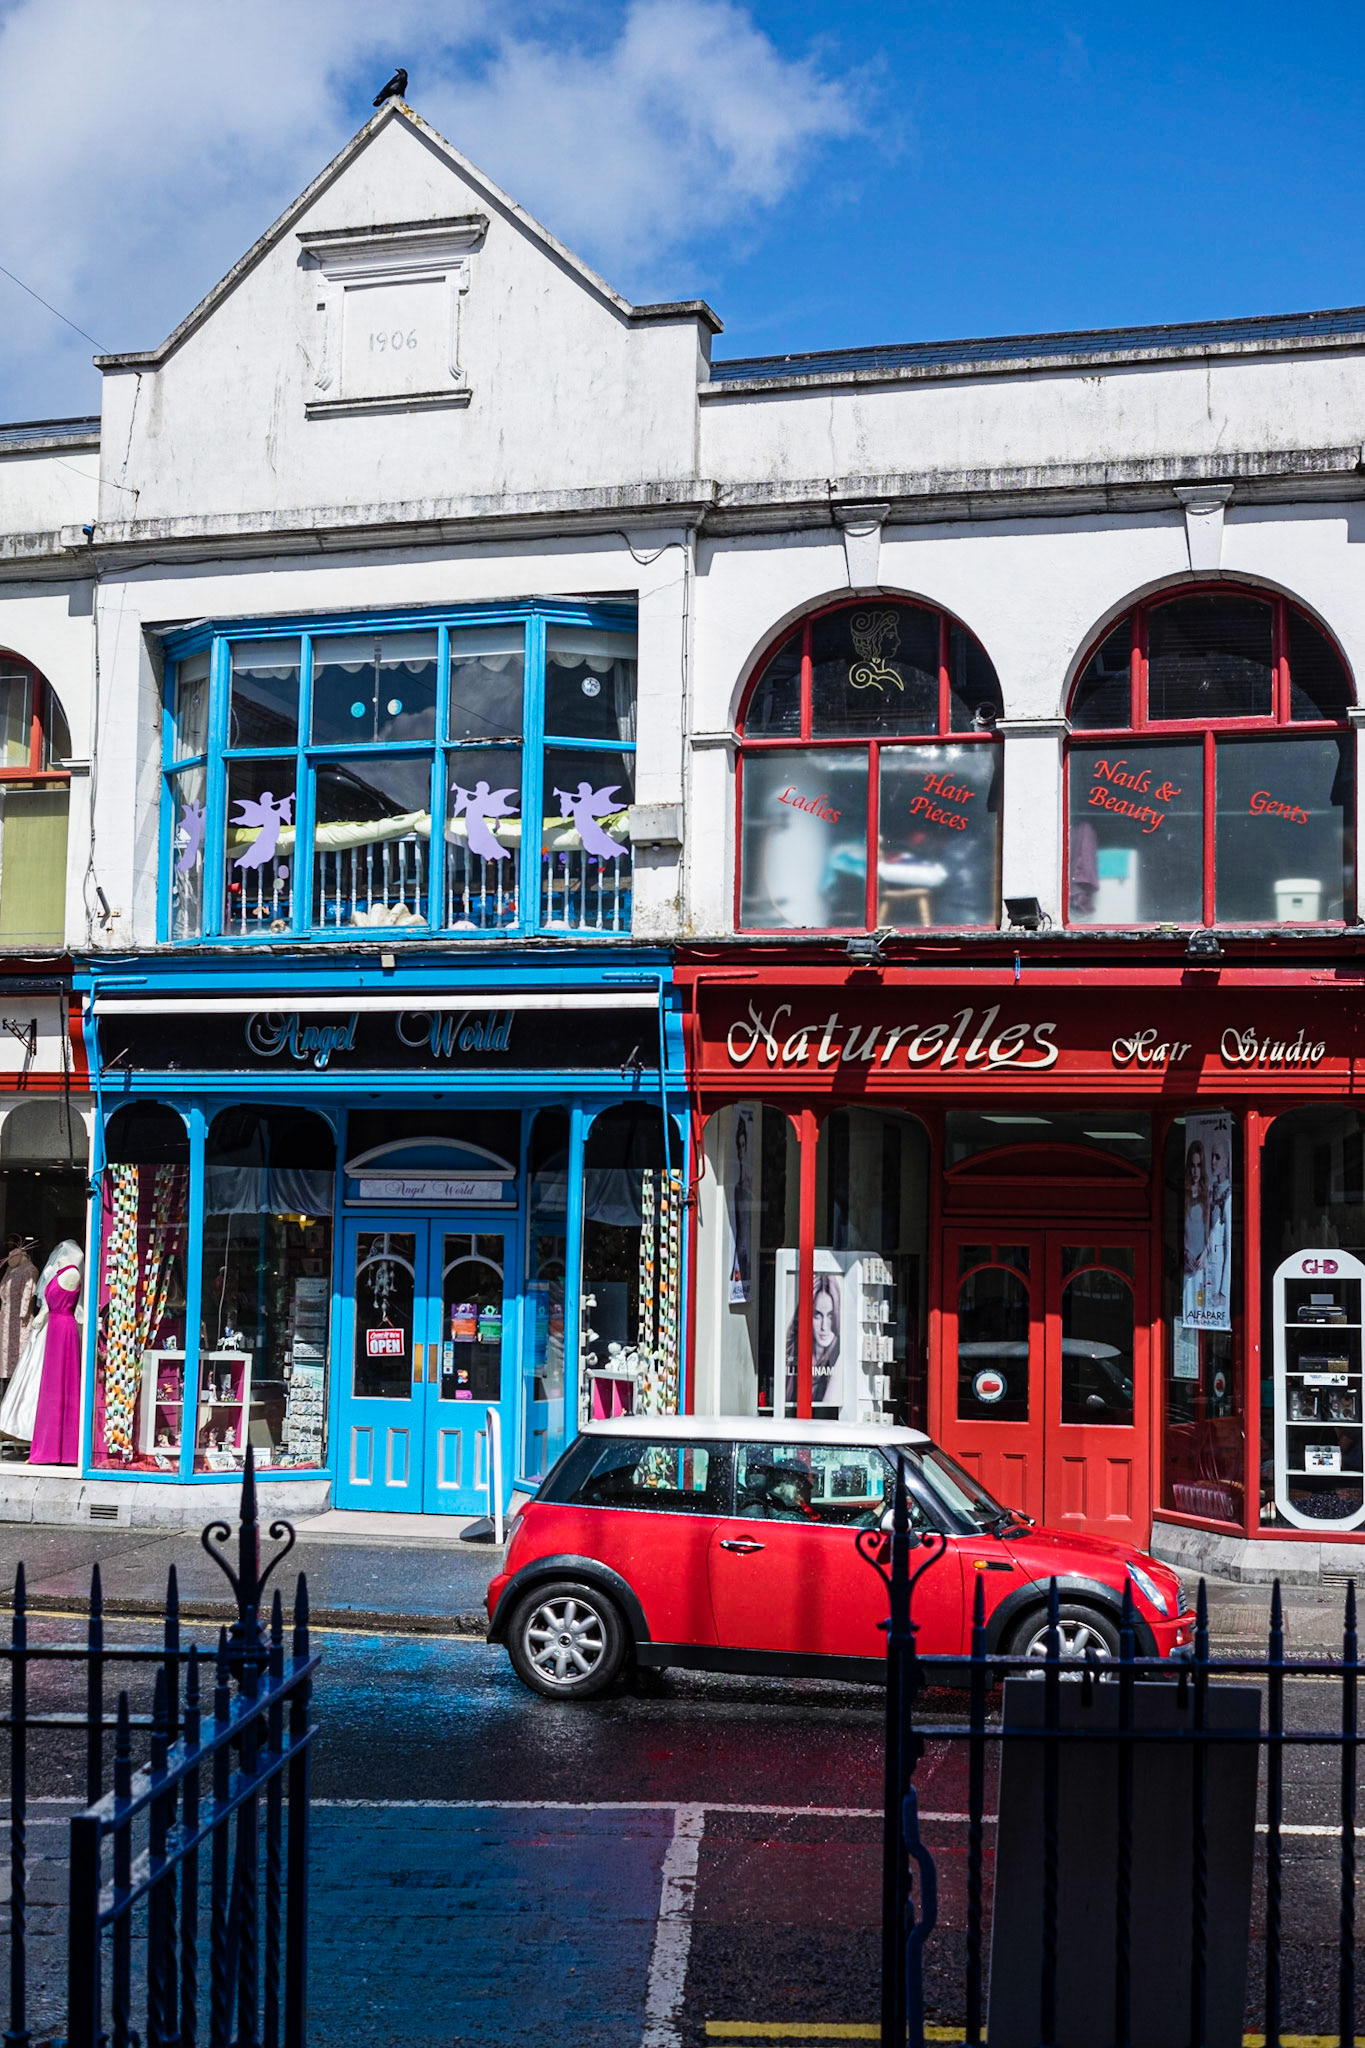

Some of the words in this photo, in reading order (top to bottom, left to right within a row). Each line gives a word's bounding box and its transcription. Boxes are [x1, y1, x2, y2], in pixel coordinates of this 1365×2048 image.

[370, 328, 418, 352] 1906
[923, 773, 976, 804] Hair
[1093, 760, 1152, 793] Nails
[1155, 781, 1182, 802] &
[778, 786, 842, 824] Ladies
[910, 796, 969, 831] Pieces
[1088, 786, 1165, 834] Beauty
[1249, 790, 1311, 825] Gents
[245, 1011, 359, 1068] Angel
[396, 1011, 514, 1058] World
[727, 998, 1059, 1072] Naturelles
[1112, 1028, 1192, 1062] Hair
[1220, 1027, 1326, 1062] Studio
[385, 1181, 426, 1197] Angel
[432, 1181, 474, 1195] World
[370, 1339, 400, 1354] OPEN
